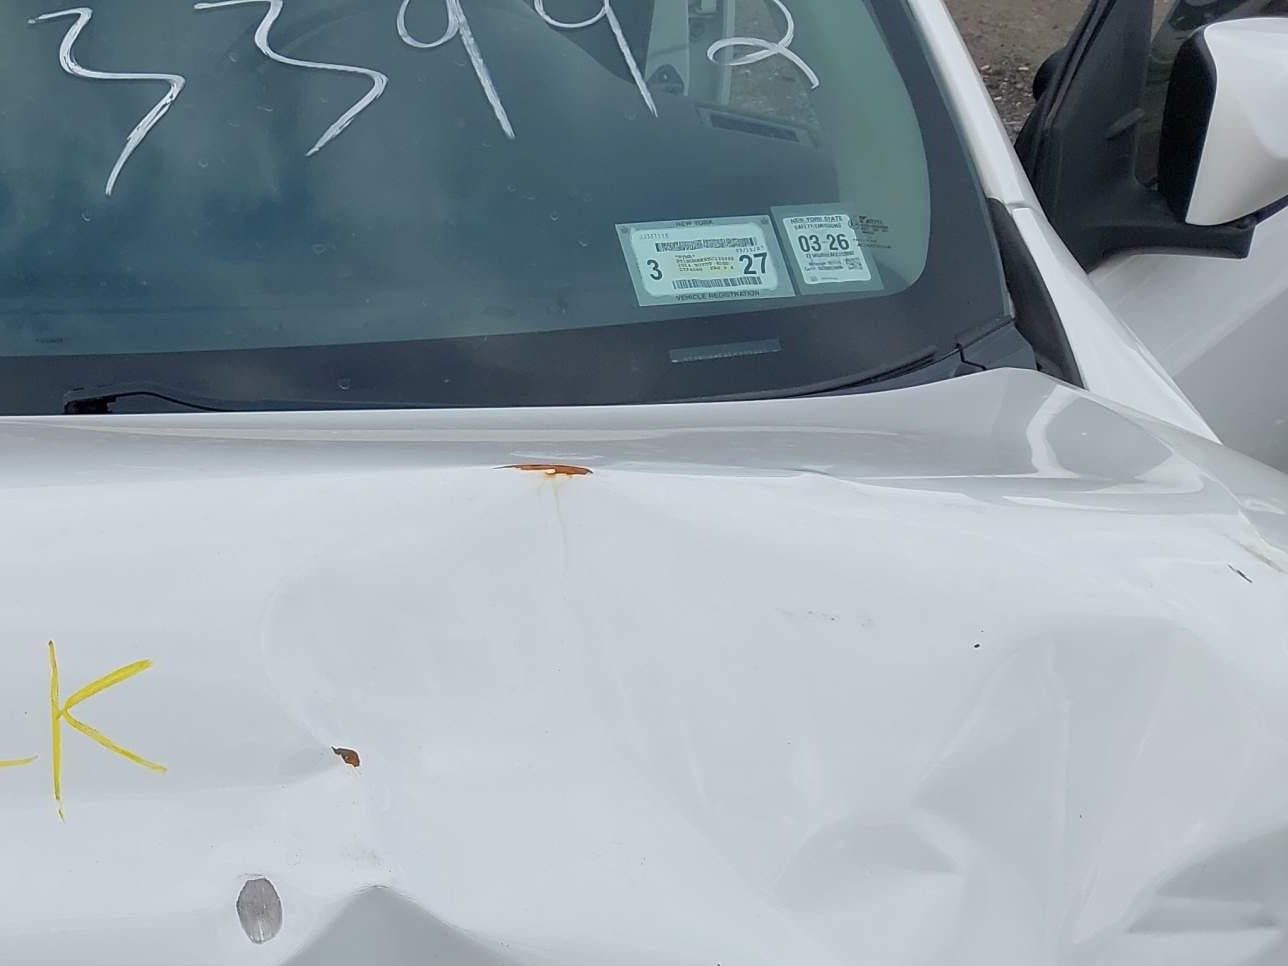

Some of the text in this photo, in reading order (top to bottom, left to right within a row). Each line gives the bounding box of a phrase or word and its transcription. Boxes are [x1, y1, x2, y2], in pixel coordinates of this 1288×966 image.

[798, 234, 850, 252] 03 26
[646, 259, 663, 281] 3
[739, 252, 768, 275] 27
[675, 290, 760, 301] VEHICLE REGISTRATION
